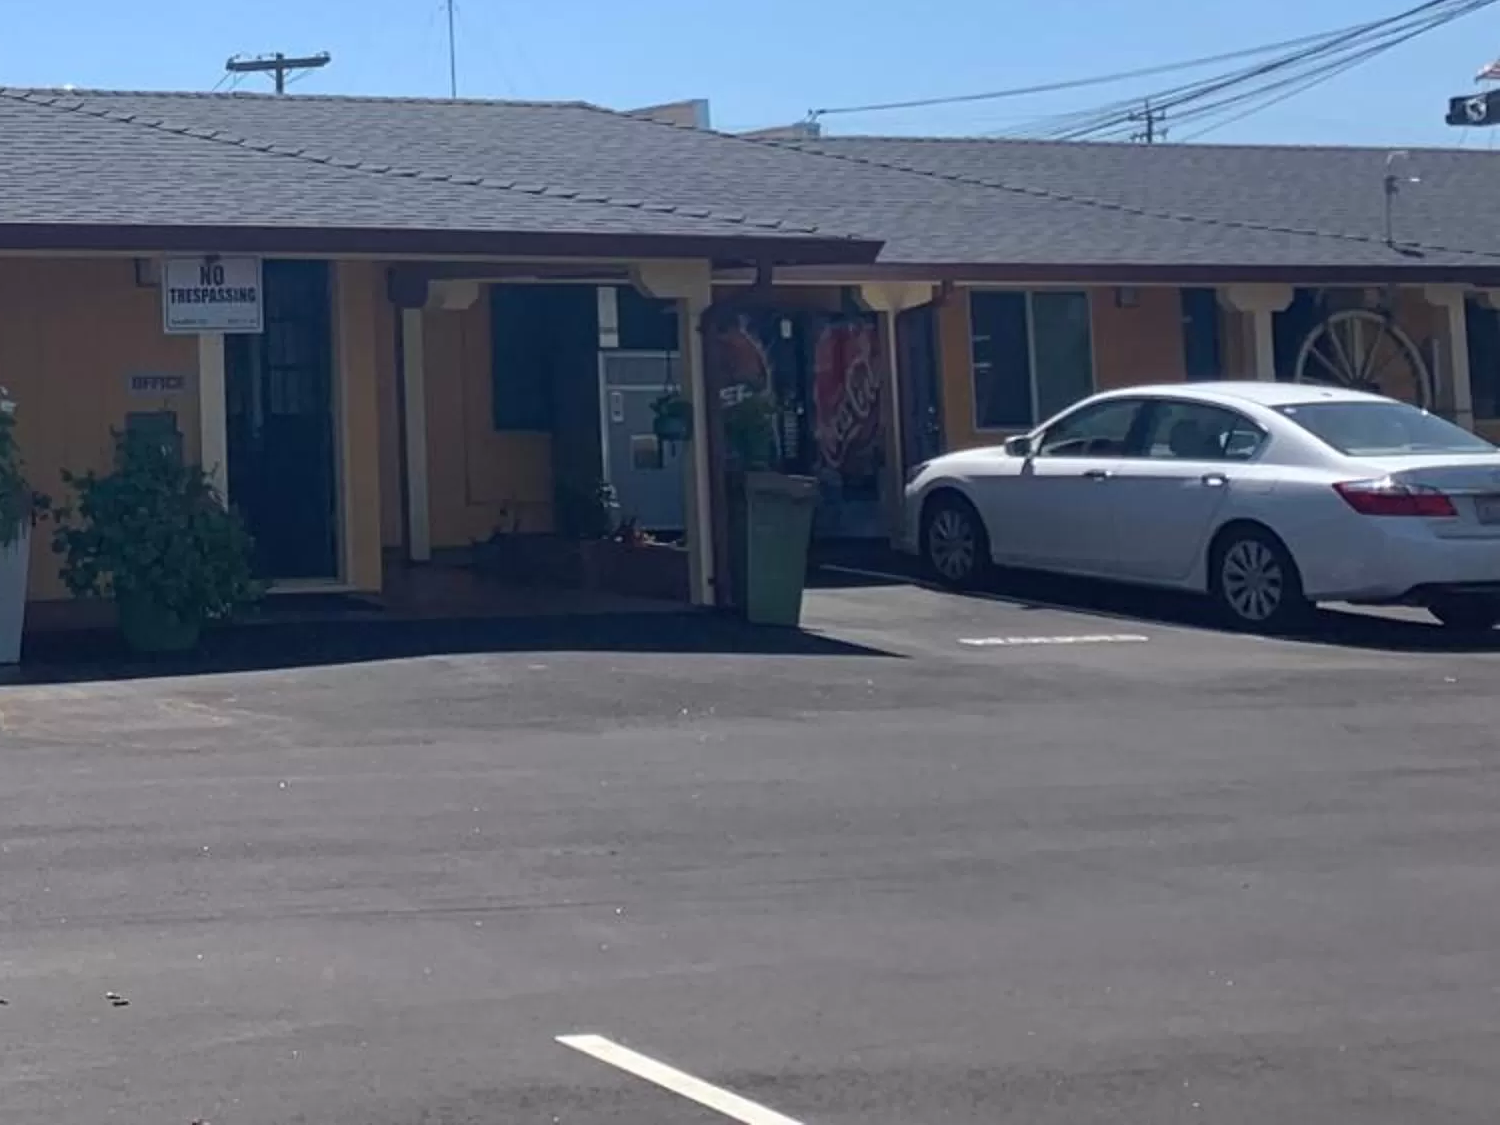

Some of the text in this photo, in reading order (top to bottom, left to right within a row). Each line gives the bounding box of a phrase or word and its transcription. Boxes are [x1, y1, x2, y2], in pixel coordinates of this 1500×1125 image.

[199, 264, 225, 286] NO
[170, 286, 257, 304] TRESPASSING
[131, 376, 184, 390] OFFICE
